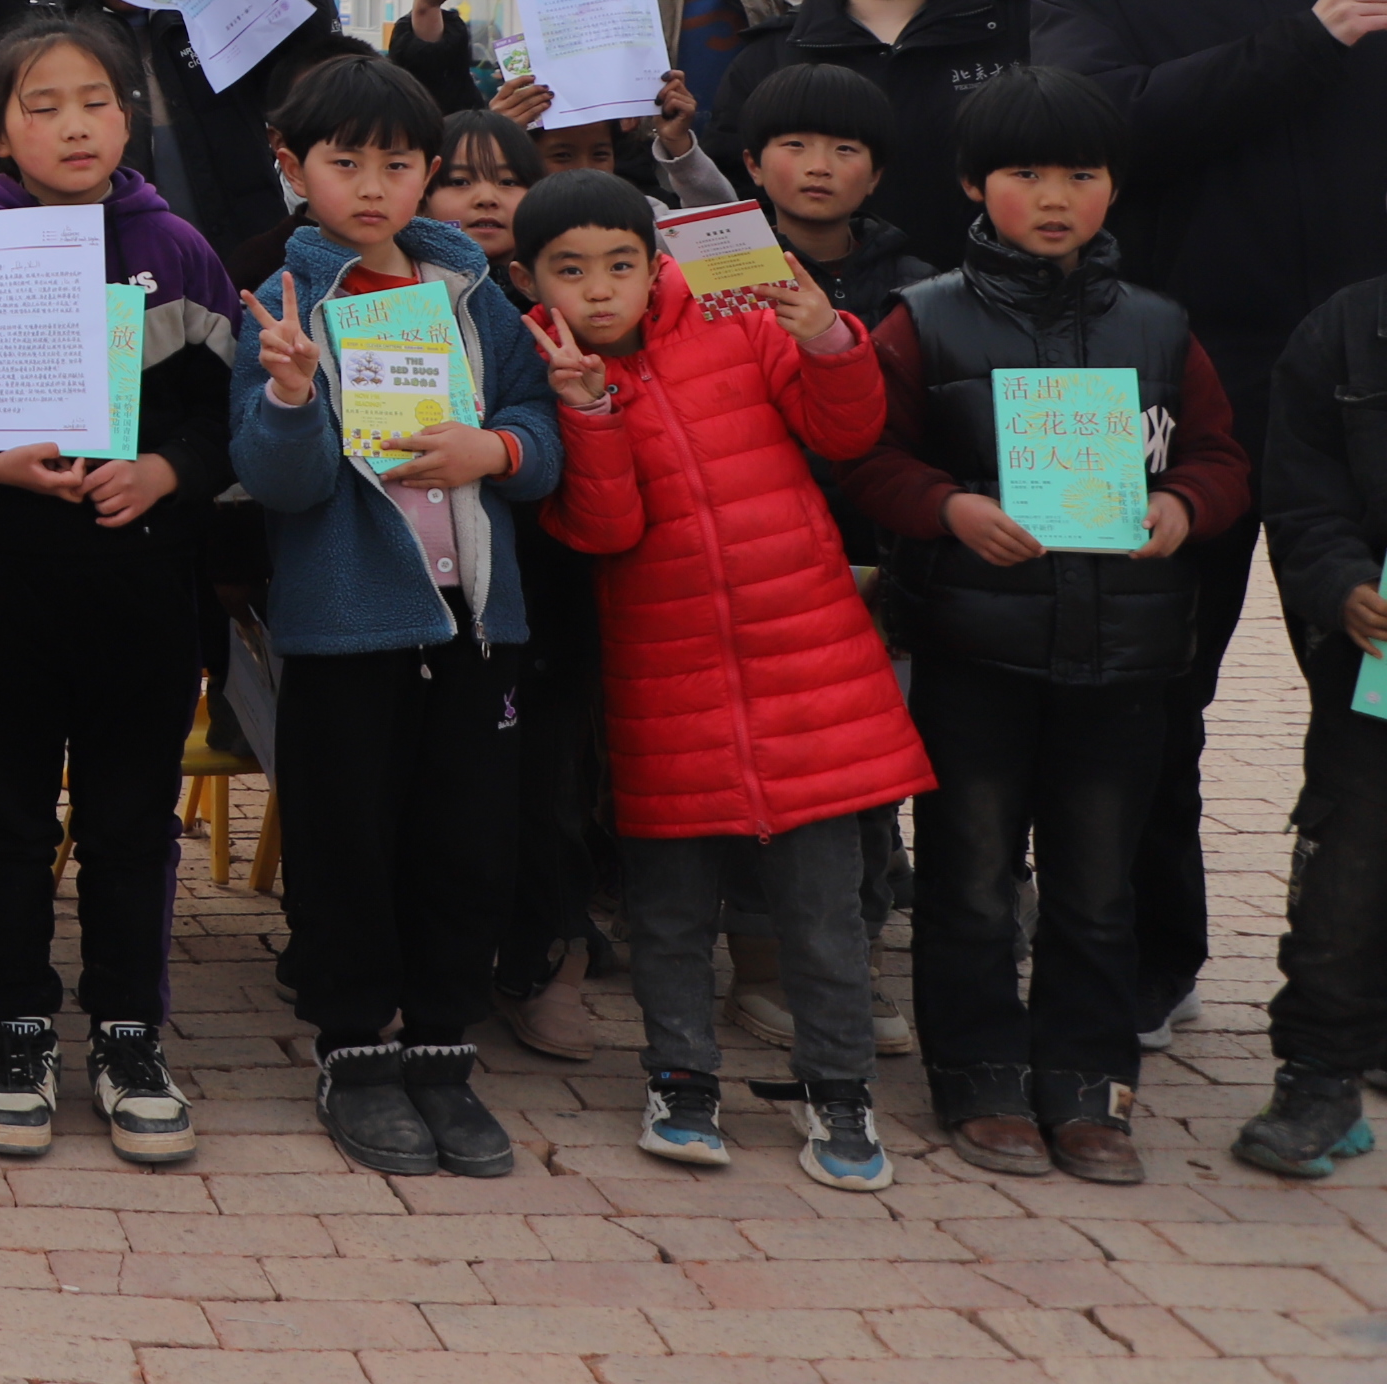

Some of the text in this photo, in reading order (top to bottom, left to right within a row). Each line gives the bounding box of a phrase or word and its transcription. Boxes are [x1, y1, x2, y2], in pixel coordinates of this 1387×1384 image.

[337, 299, 390, 329] 活出
[390, 366, 439, 376] BED BUGS
[405, 357, 424, 365] THE
[1003, 376, 1063, 400] 活出
[1005, 411, 1134, 436] 心花怒放
[1009, 445, 1104, 471] 的人生
